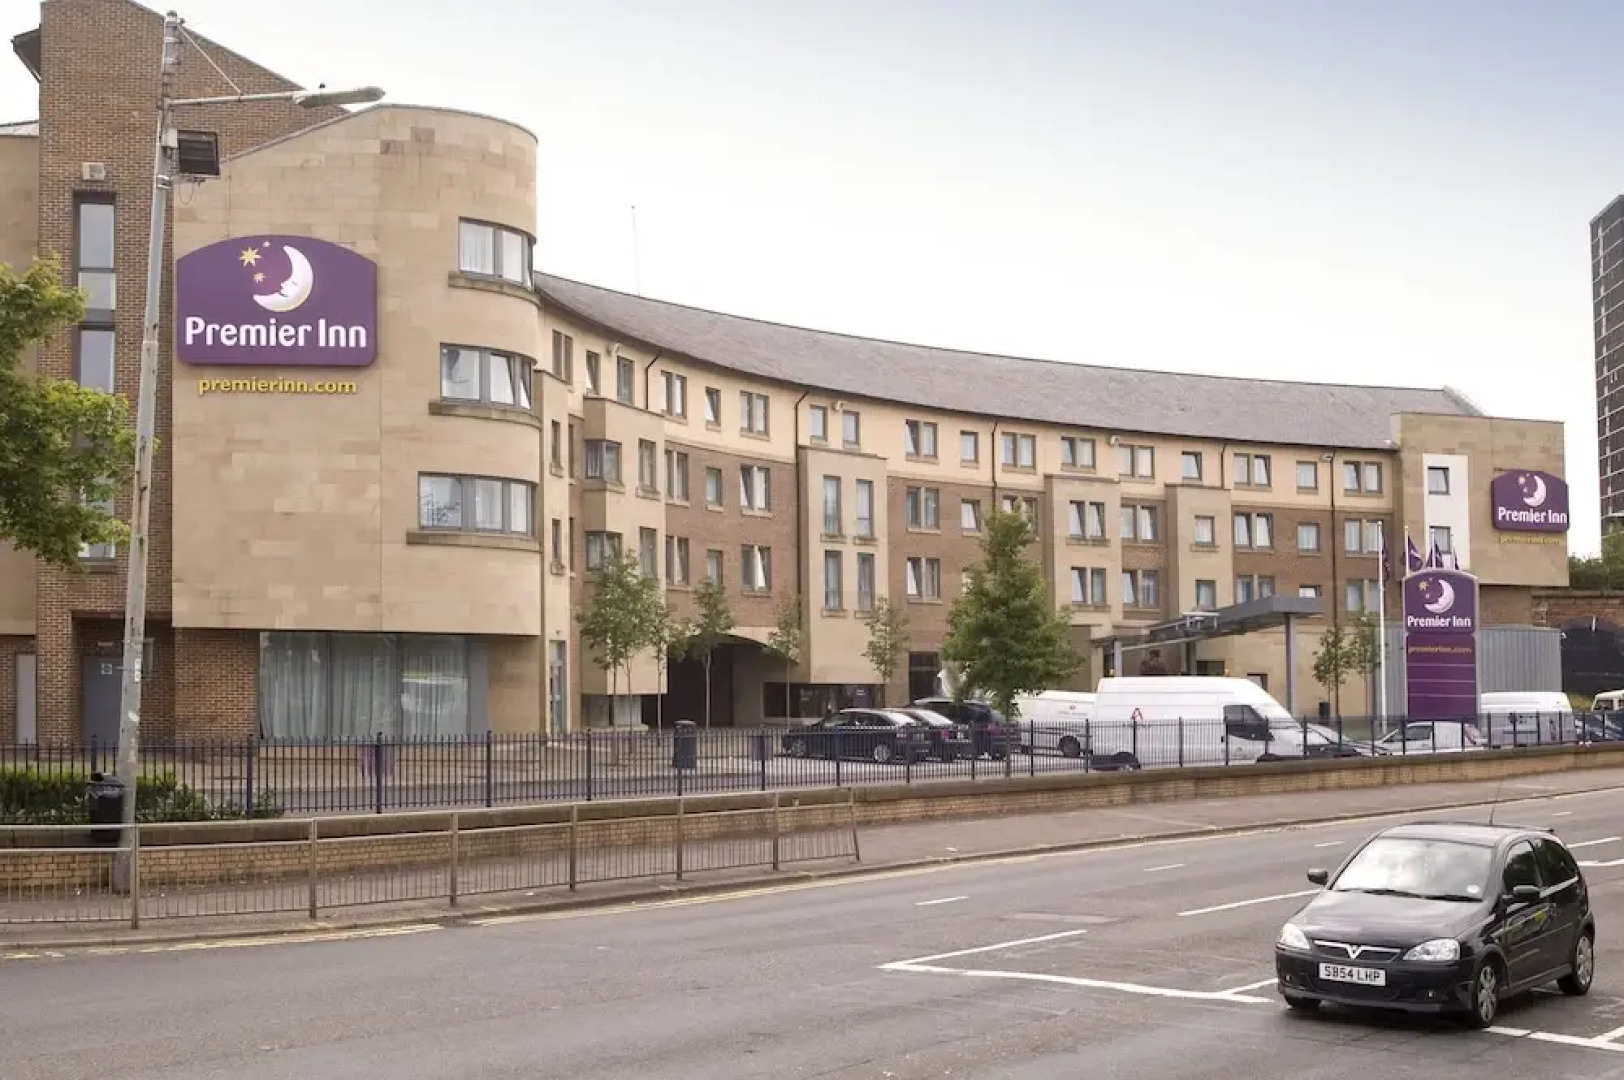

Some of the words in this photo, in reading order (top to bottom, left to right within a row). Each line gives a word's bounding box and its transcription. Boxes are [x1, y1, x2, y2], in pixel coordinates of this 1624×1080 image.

[185, 316, 313, 347] Premier
[318, 318, 367, 348] Inn
[198, 376, 358, 396] premierinn.com
[1498, 506, 1546, 523] Premier
[1548, 509, 1568, 524] Inn
[1407, 615, 1451, 628] Premier
[1452, 615, 1472, 628] Inn
[1357, 969, 1381, 982] LHP
